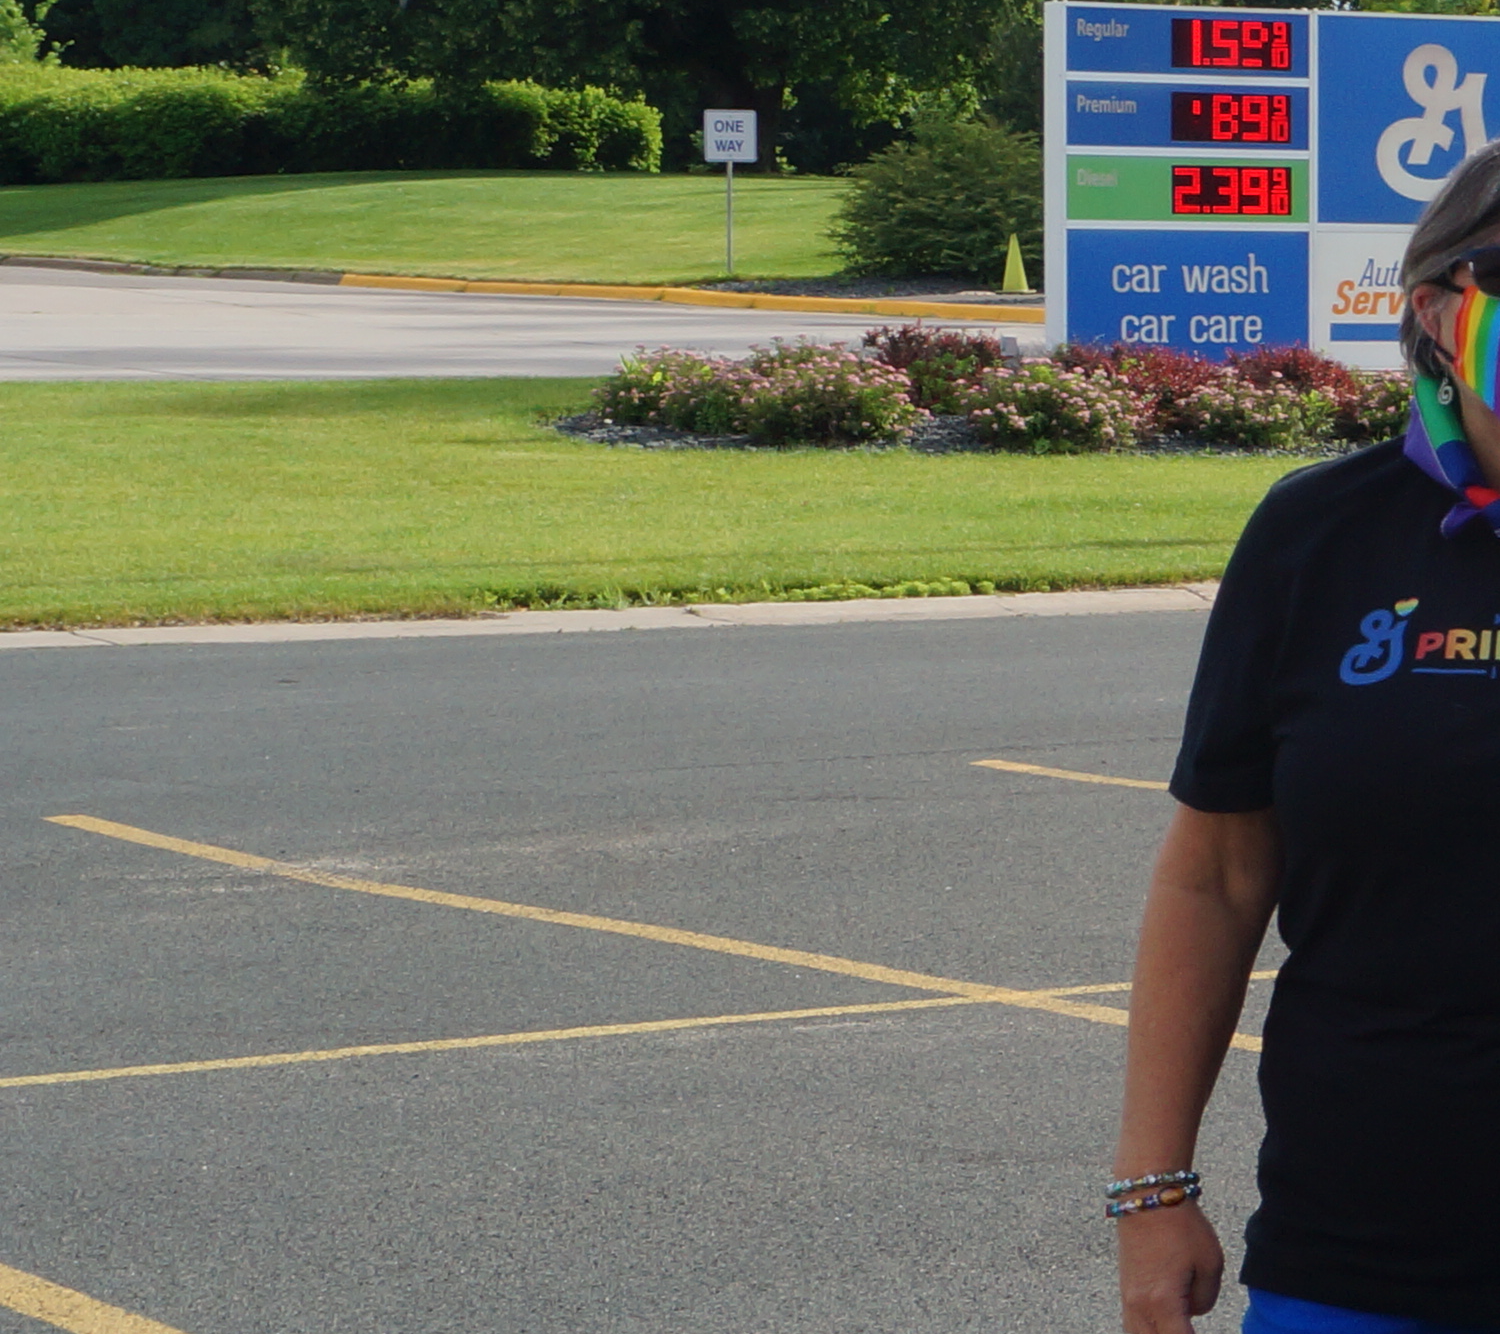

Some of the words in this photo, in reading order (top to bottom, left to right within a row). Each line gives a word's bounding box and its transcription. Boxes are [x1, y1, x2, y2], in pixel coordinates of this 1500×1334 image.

[1076, 18, 1129, 41] Regular
[1076, 94, 1137, 114] Premium
[714, 119, 744, 133] ONE
[714, 139, 744, 153] WAY
[1076, 168, 1118, 186] Diesel
[1173, 167, 1269, 214] 2.39
[1112, 264, 1168, 293] car
[1181, 252, 1270, 293] wash
[1357, 257, 1403, 287] Aut
[1331, 279, 1405, 315] Serv
[1121, 314, 1176, 343] car
[1189, 314, 1263, 343] care
